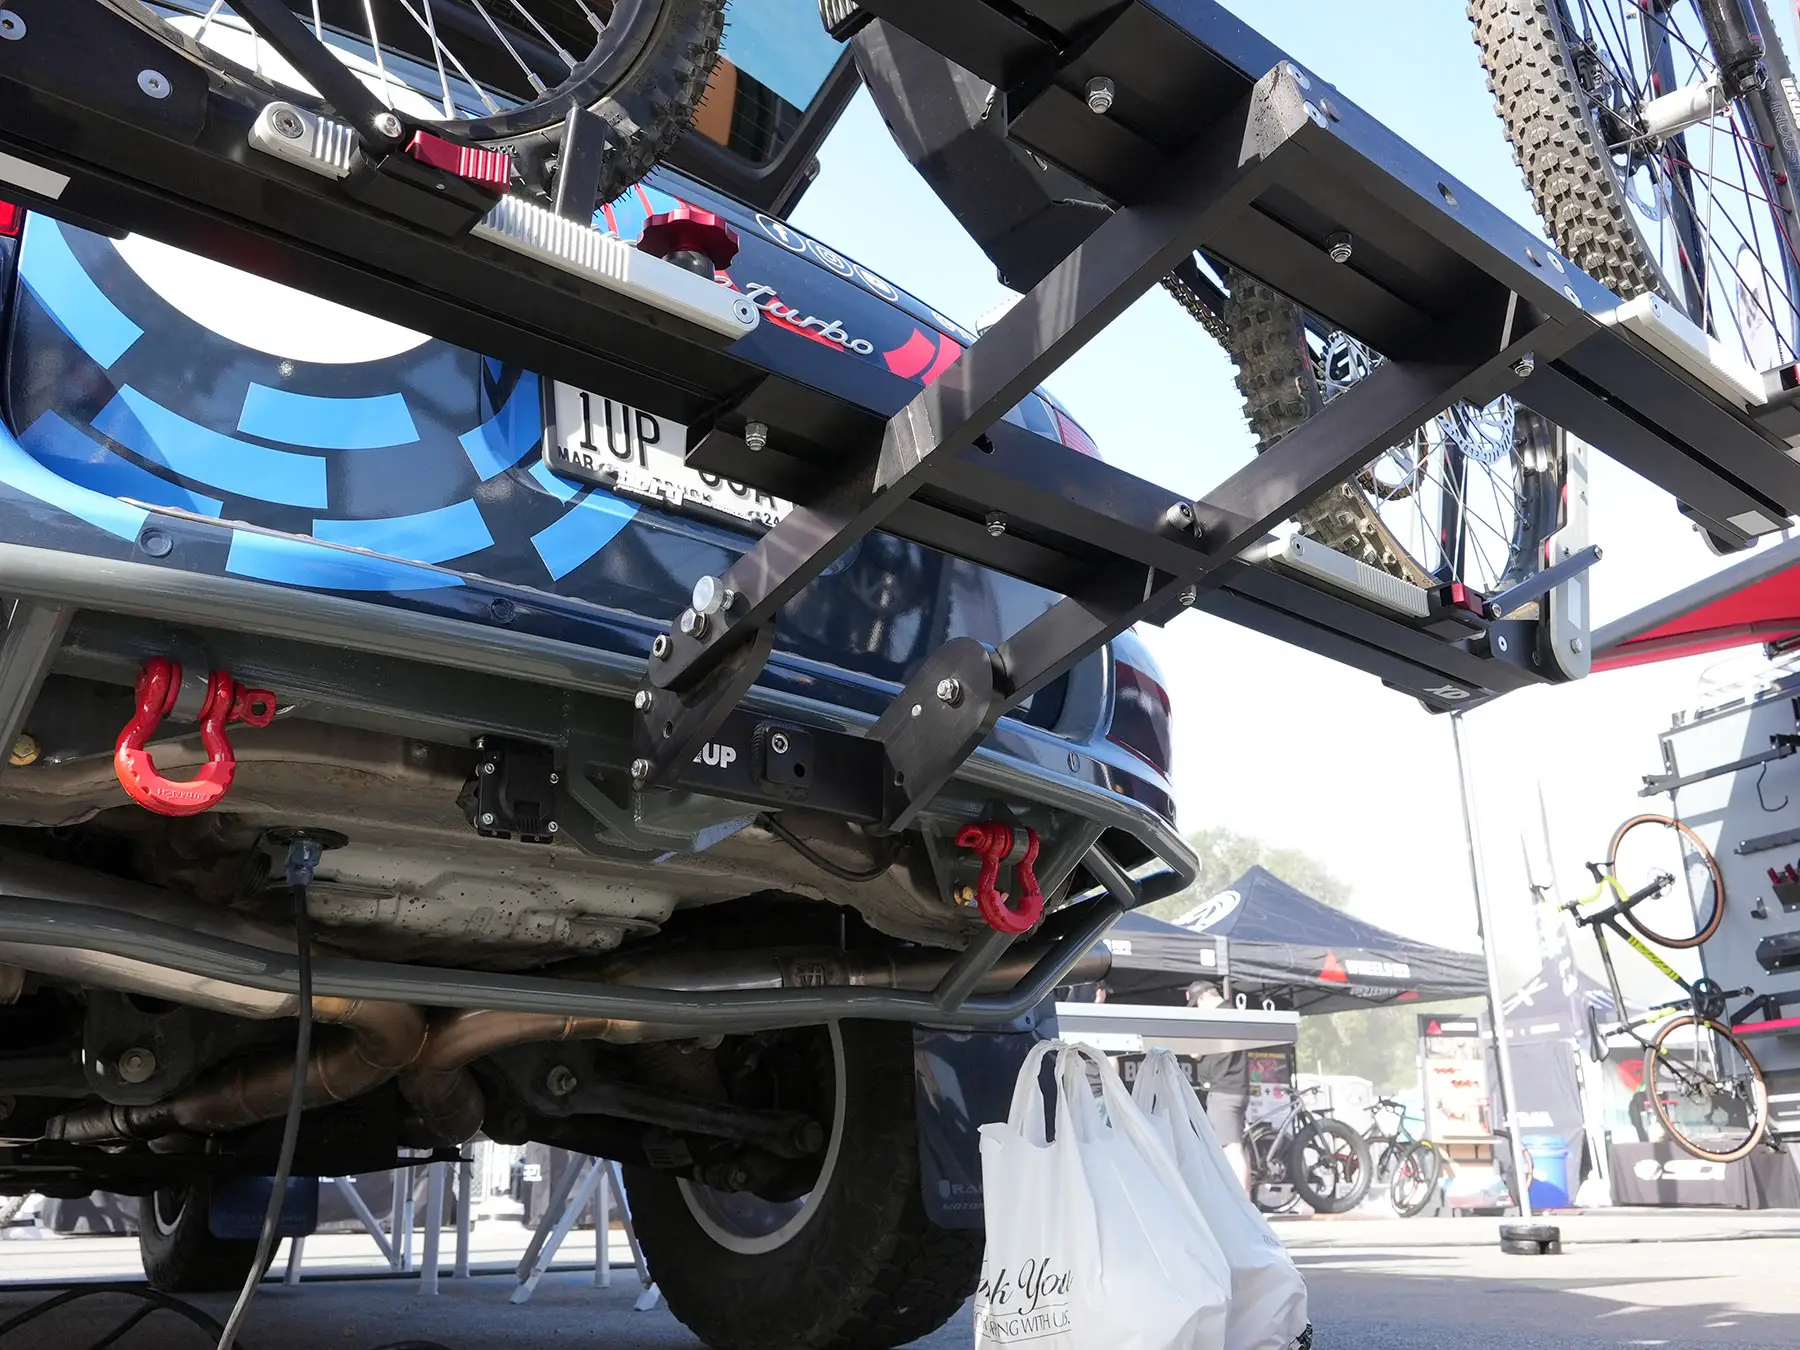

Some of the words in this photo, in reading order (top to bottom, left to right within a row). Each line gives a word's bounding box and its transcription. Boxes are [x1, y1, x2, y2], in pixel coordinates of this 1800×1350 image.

[580, 391, 660, 467] 1UP
[558, 445, 594, 470] MAR
[1017, 1257, 1073, 1316] You
[1021, 1313, 1051, 1333] WITH
